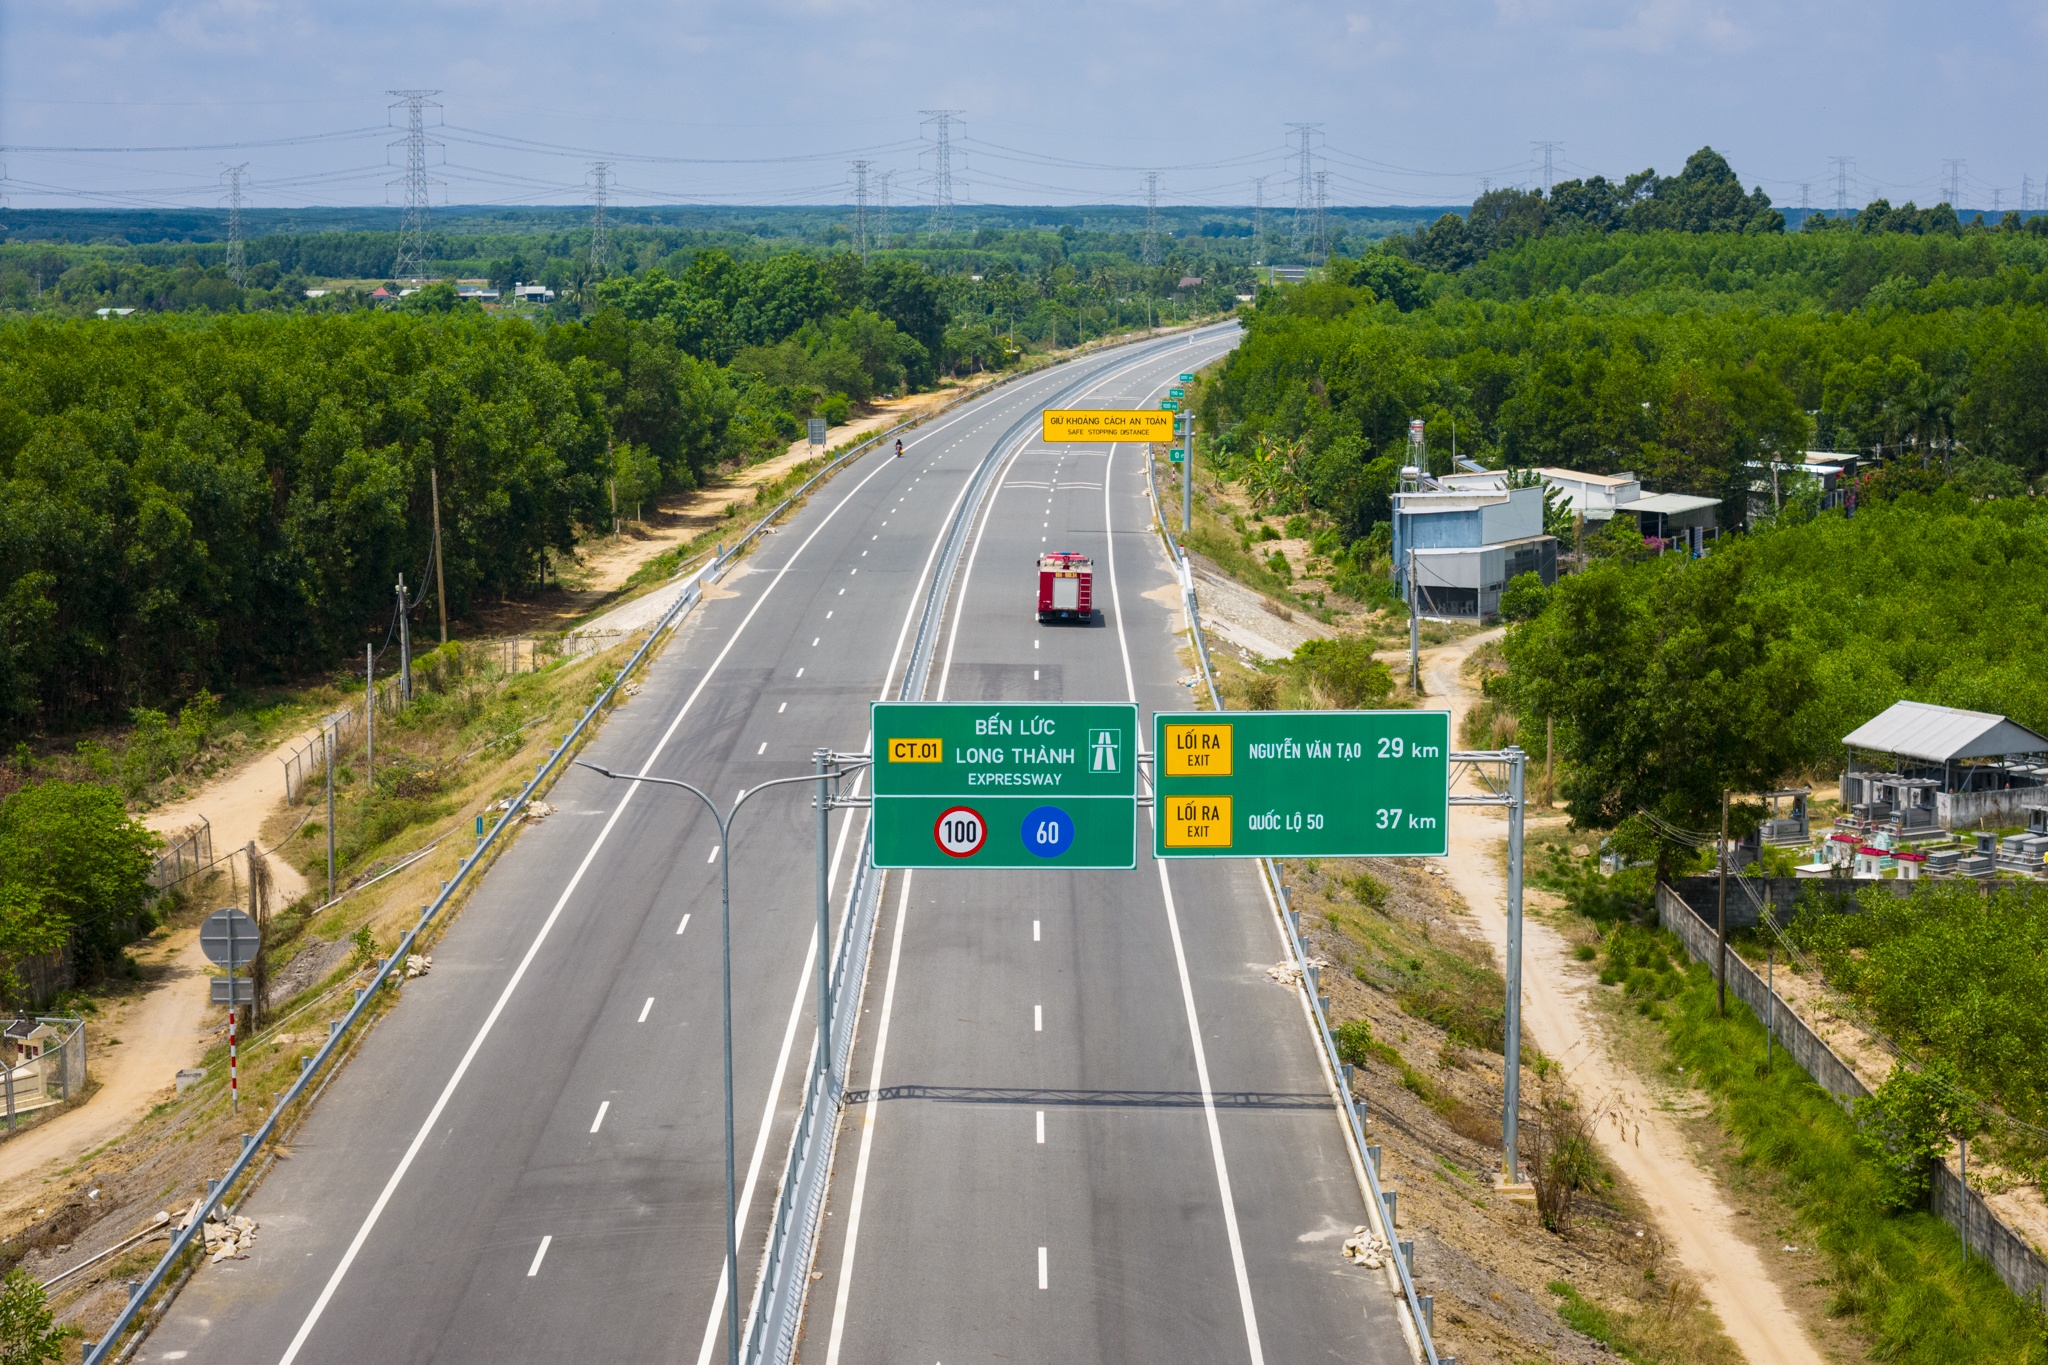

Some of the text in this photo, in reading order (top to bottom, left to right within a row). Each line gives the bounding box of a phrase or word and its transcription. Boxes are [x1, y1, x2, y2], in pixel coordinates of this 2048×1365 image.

[1050, 414, 1167, 425] GIỮ KHOẢNG CÁCH AN TOÀN
[1067, 428, 1150, 436] SAFE STOPPING DISTANCE
[975, 712, 1056, 735] BẾN LỨC
[1177, 729, 1220, 749] LỐI RA
[1377, 737, 1439, 759] 29 km
[894, 742, 938, 758] CT.01
[956, 745, 1075, 764] LONG THÀNH
[1249, 737, 1362, 762] NGUYỄN VĂN TẠO
[1187, 754, 1210, 767] EXIT
[968, 773, 1062, 786] EXPRESSWAY
[1177, 801, 1220, 821] LỐI RA
[1248, 809, 1324, 833] QUỐC LỘ 50
[1375, 809, 1436, 830] 37 km
[944, 820, 977, 843] 100
[1036, 821, 1059, 844] 60
[1187, 825, 1210, 838] EXIT
